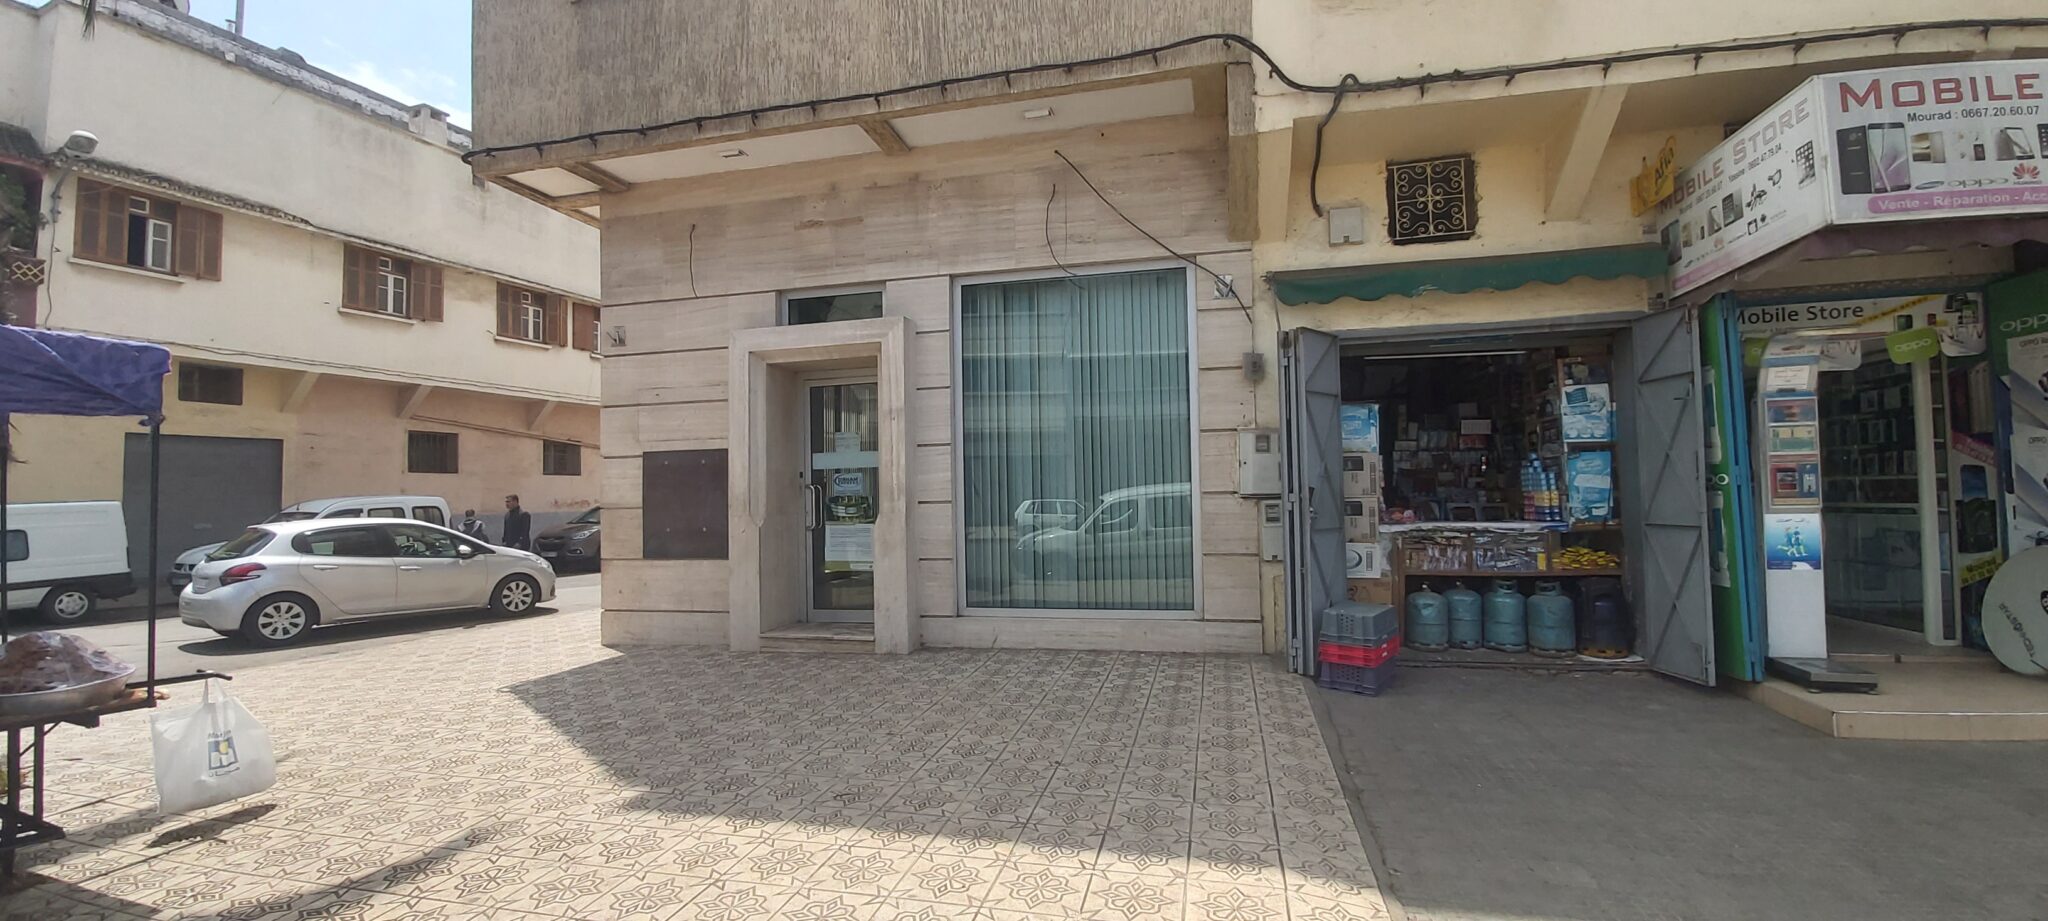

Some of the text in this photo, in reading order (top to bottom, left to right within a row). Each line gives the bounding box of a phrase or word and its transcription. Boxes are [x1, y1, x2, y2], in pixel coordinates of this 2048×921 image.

[1839, 73, 2043, 112] MOBILE
[1907, 110, 1951, 123] Mourad
[1961, 105, 2040, 119] 0667.20.60.07
[1732, 98, 1810, 166] STORE
[1878, 198, 1920, 211] Vente
[1933, 191, 2011, 207] Réparation
[1806, 305, 1865, 321] Store
